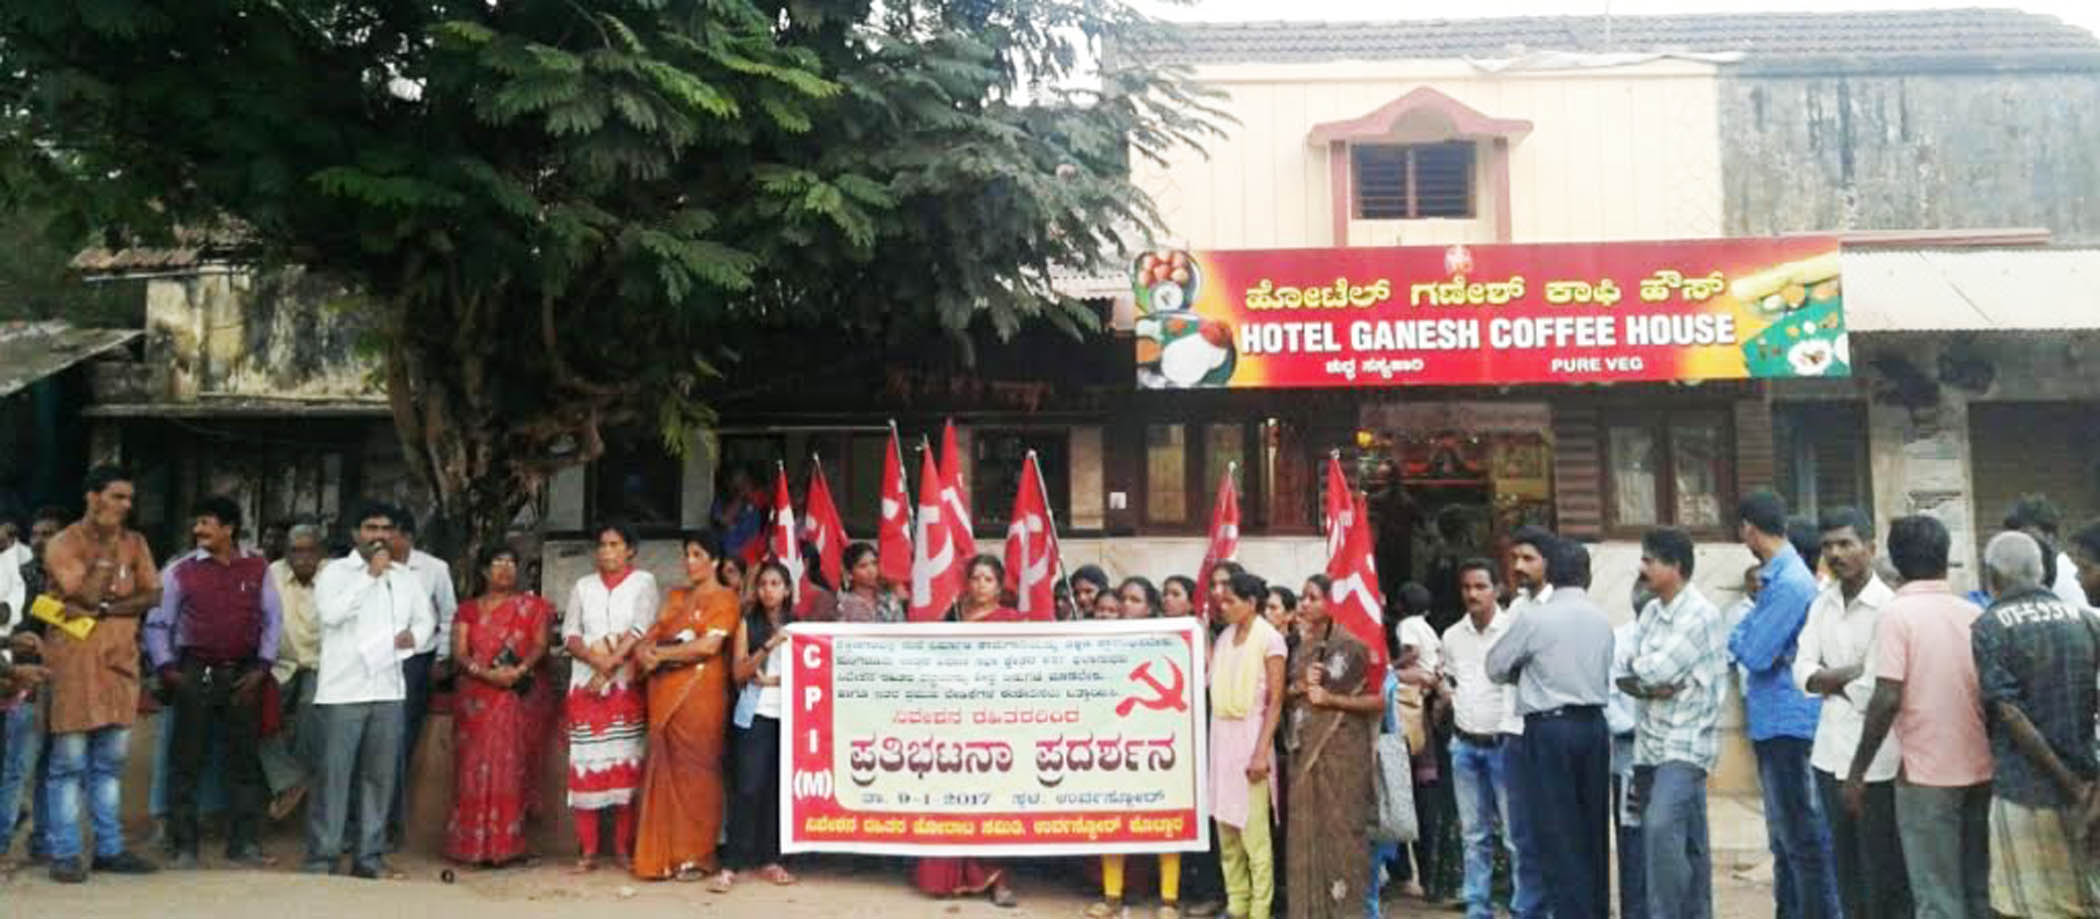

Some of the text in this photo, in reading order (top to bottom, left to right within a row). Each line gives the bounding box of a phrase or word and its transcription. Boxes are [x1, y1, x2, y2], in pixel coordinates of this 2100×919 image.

[1246, 278, 1390, 309] ಹೋಟೆಲ್
[1410, 275, 1525, 306] ಗಣೇಶ್
[1640, 270, 1725, 301] ಹೌಸ್
[1241, 312, 1736, 354] HOTEL GANESH COFFEE HOUSE
[1551, 356, 1645, 373] PURE VEG
[850, 730, 1176, 788] ಪ್ರತಿಭಟನಾ ಪ್ರದರ್ಶನ
